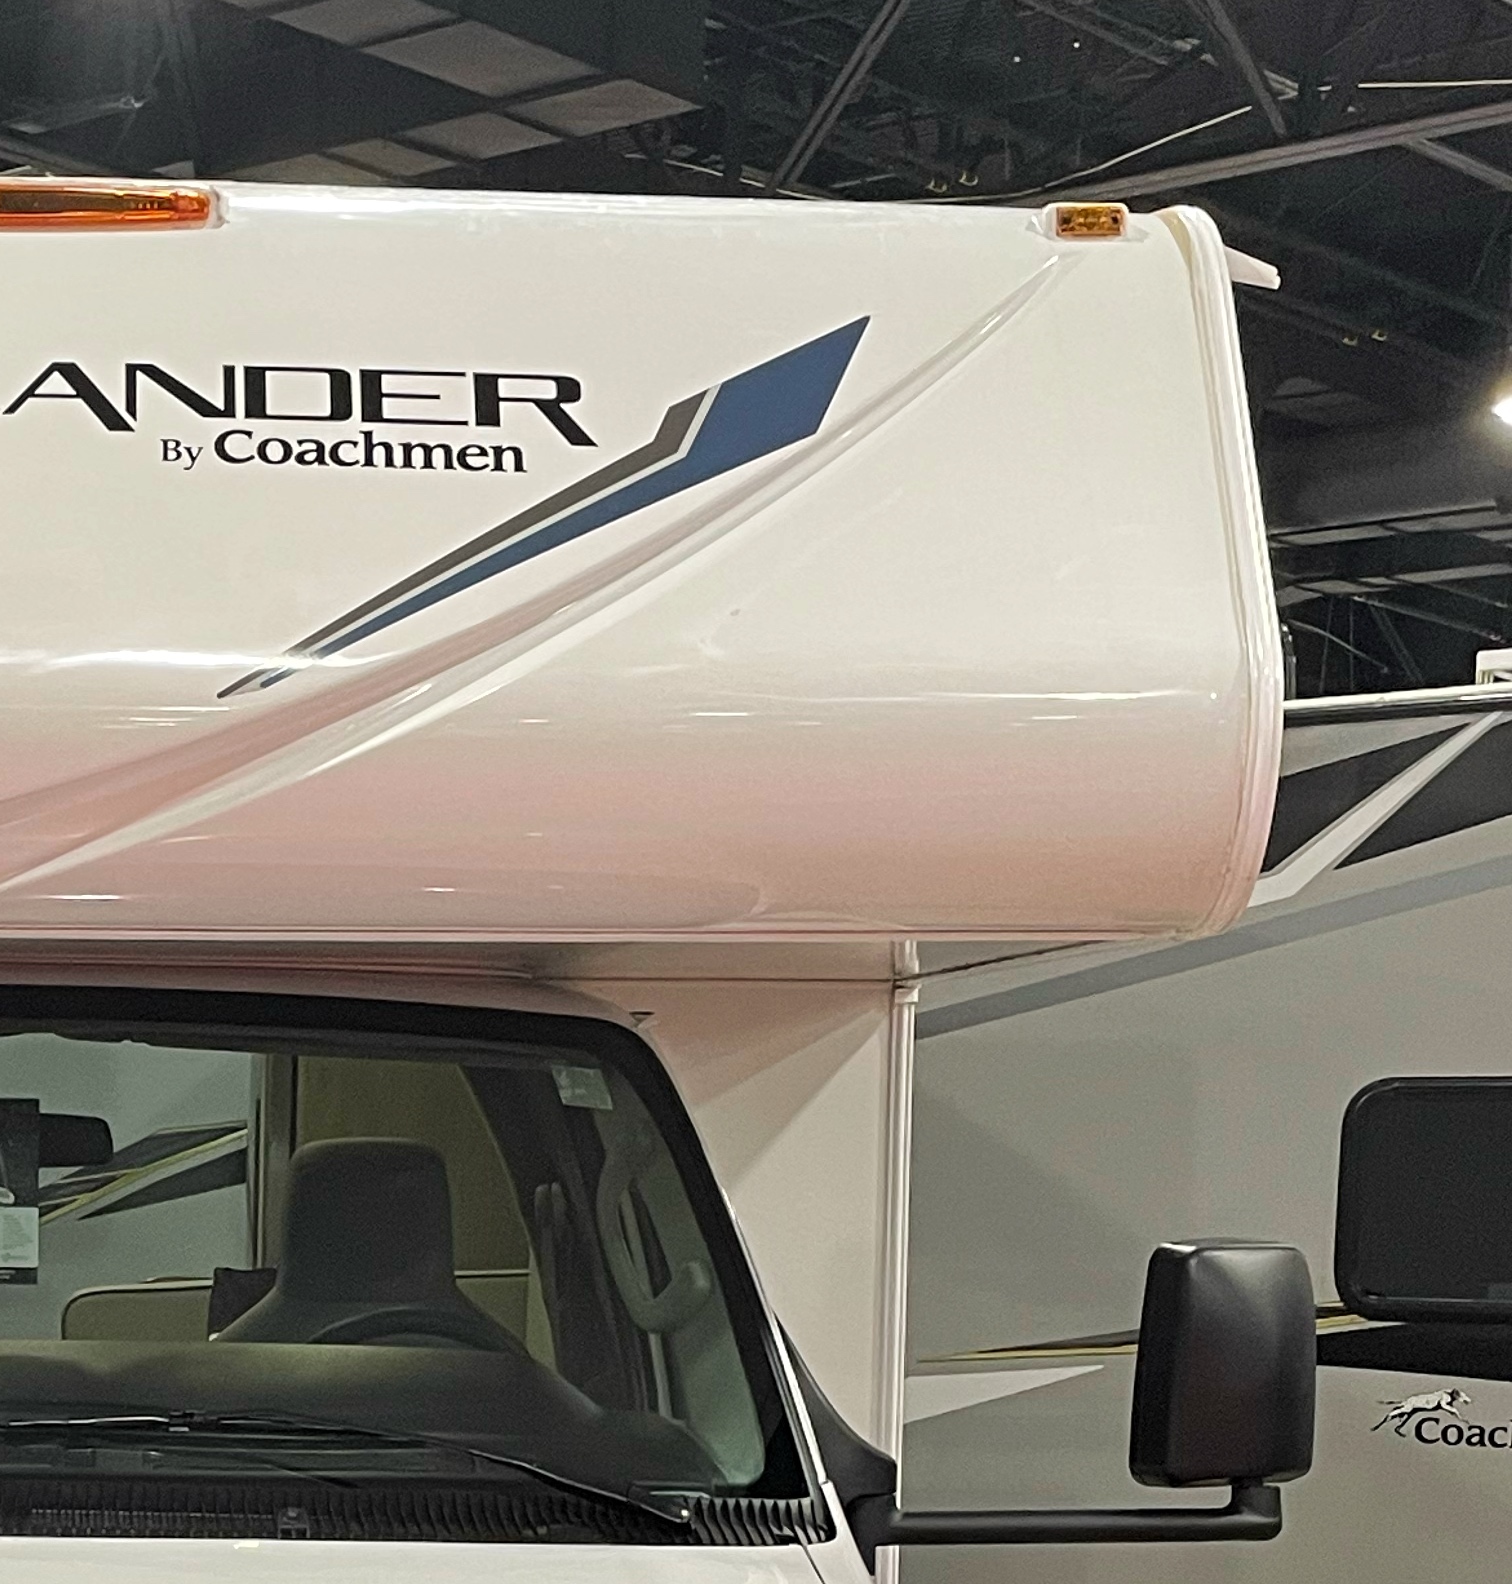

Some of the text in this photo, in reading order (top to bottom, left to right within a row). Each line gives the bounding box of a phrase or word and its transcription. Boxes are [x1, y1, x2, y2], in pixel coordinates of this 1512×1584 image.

[159, 428, 529, 474] By Coachmen
[1414, 1416, 1512, 1449] Coac
